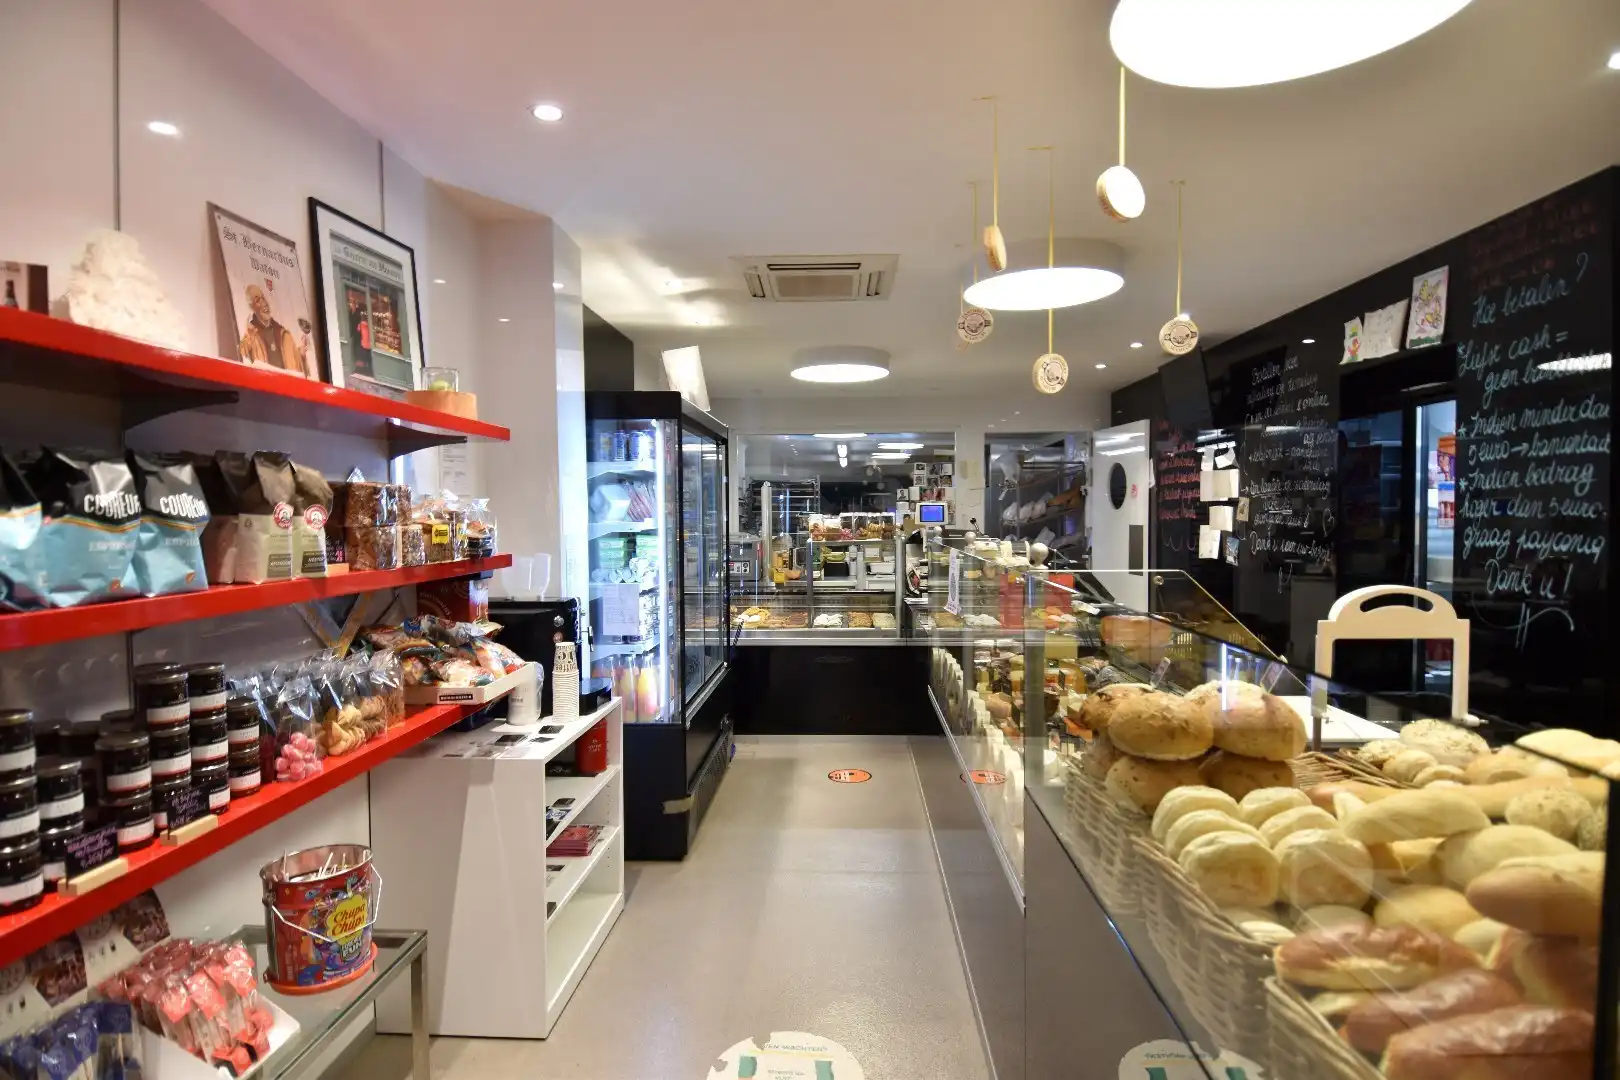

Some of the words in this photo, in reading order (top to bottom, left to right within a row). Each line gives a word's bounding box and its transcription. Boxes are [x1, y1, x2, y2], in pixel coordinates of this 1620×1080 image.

[1508, 324, 1552, 360] cash
[1520, 398, 1579, 429] minder
[1524, 460, 1597, 497] bedrag
[1506, 492, 1546, 518] dan
[1463, 526, 1512, 561] graag
[1484, 558, 1532, 595] Dank
[334, 903, 365, 924] Chupa
